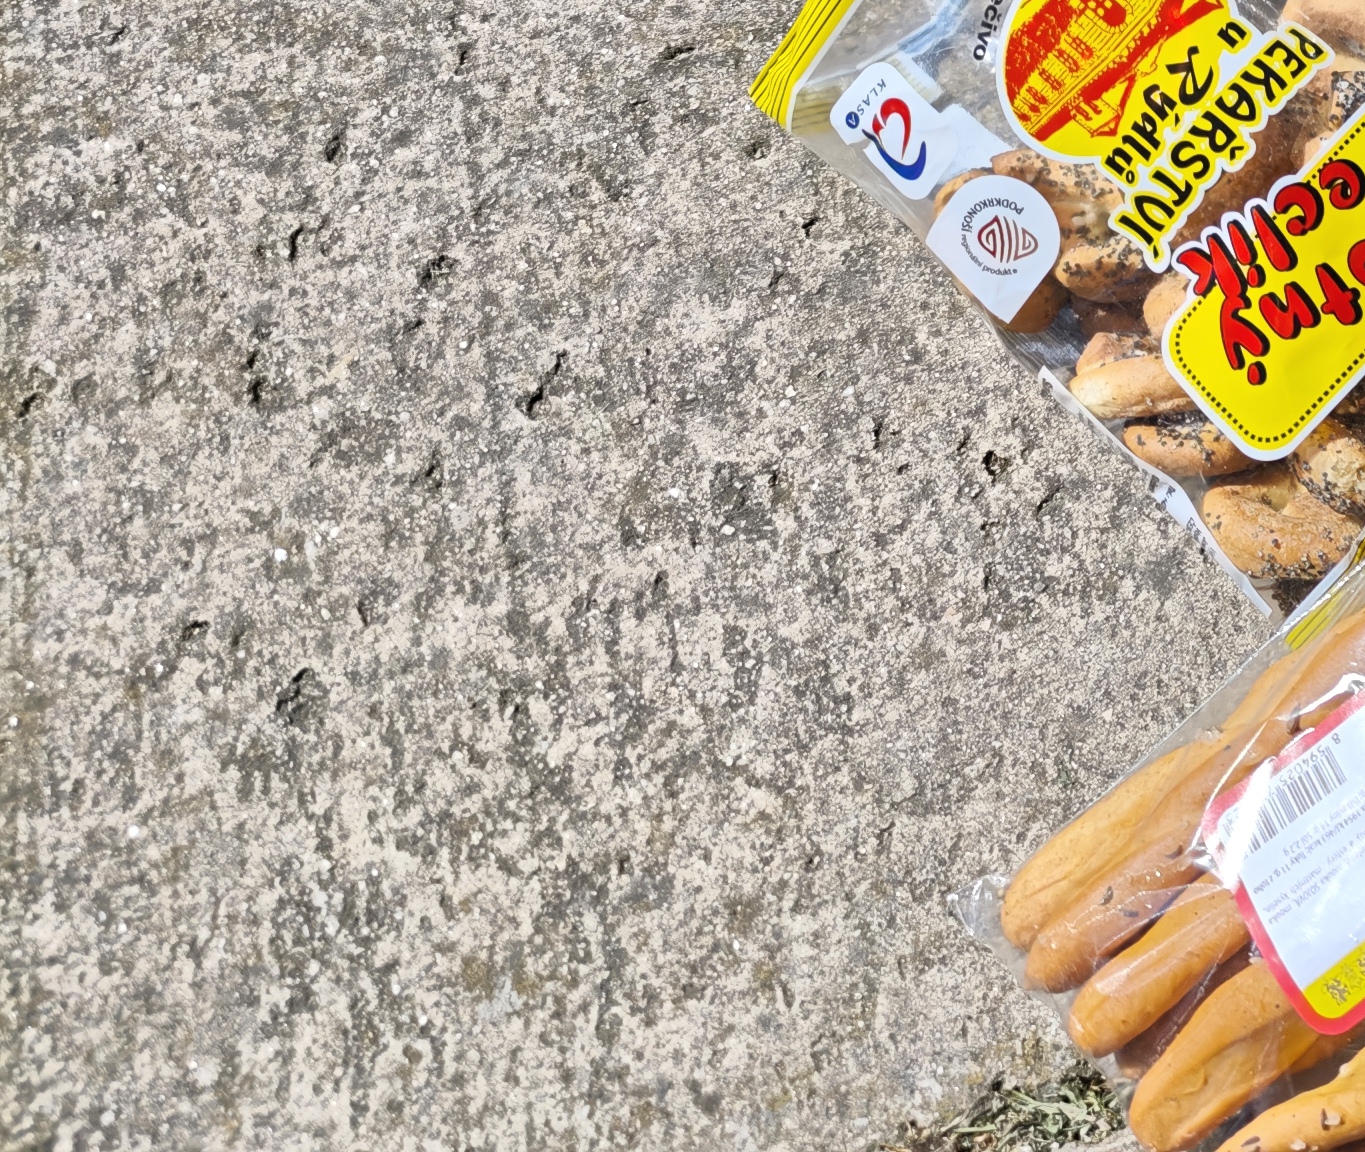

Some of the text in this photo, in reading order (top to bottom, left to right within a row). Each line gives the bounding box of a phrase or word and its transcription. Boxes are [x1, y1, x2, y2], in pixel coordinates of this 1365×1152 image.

[1214, 17, 1250, 52] u
[840, 73, 889, 131] KLASA
[1101, 46, 1217, 185] Rýdlů
[1120, 26, 1324, 260] PEKAŘSTVÍ
[961, 197, 1025, 236] PODKRKONOŠÍ
[1329, 731, 1344, 746] 8
[1276, 742, 1329, 788] 594025
